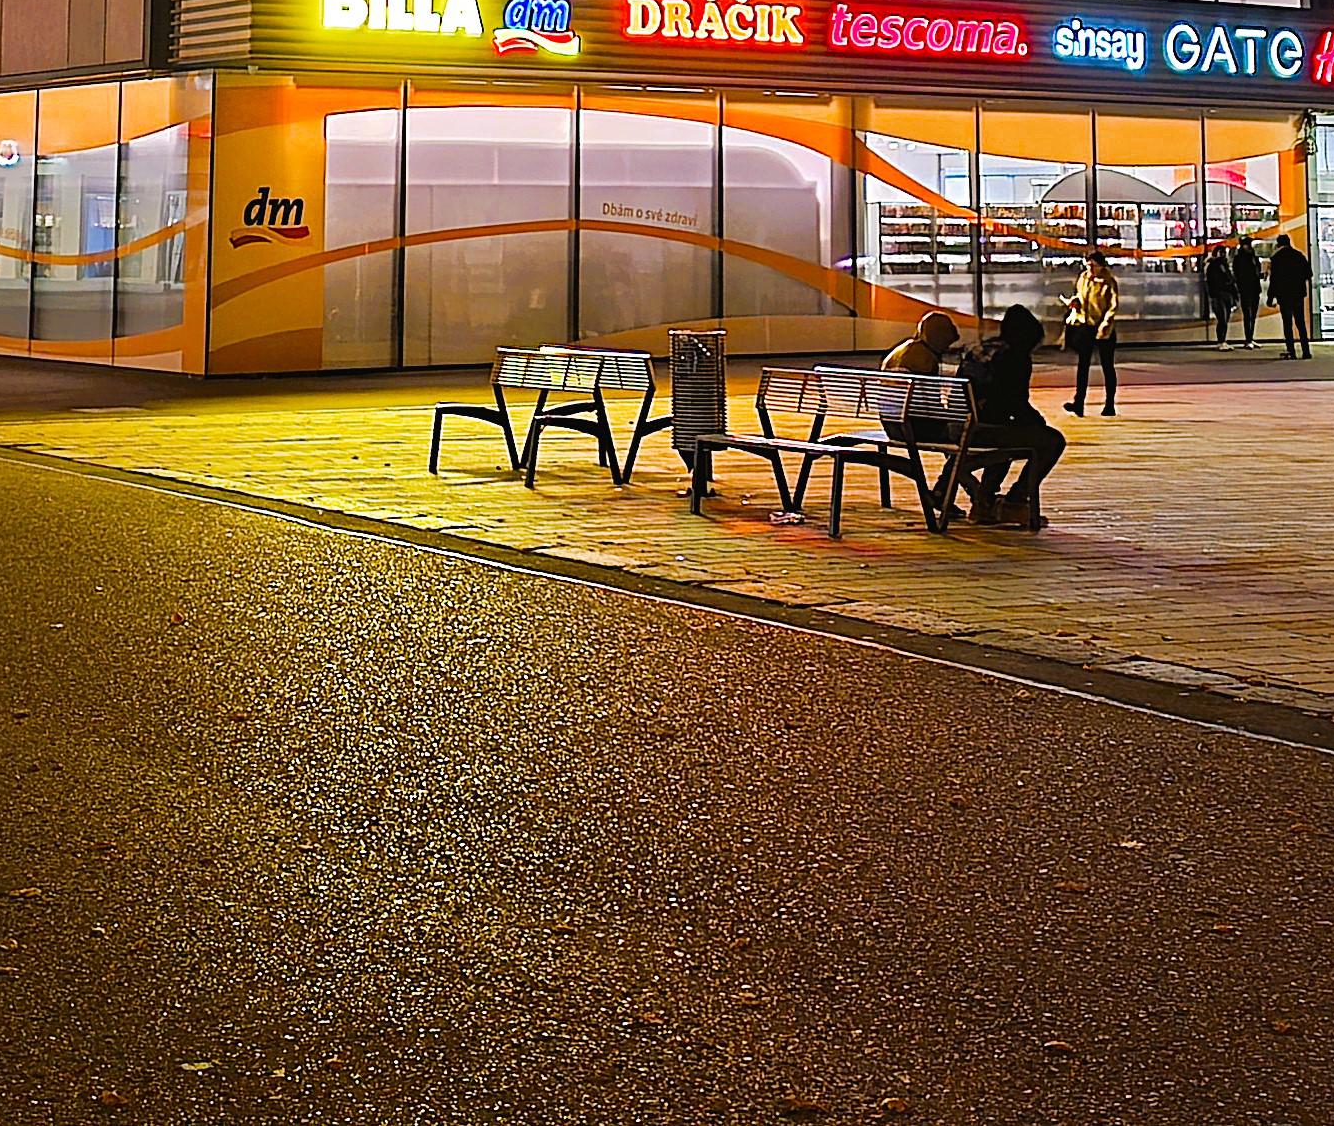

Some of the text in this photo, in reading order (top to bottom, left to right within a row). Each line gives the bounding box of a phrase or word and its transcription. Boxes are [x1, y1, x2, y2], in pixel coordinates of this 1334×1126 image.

[1055, 19, 1146, 70] sinsay
[243, 186, 304, 226] dm
[602, 202, 634, 218] Dbám
[635, 209, 643, 219] o
[644, 208, 663, 222] své
